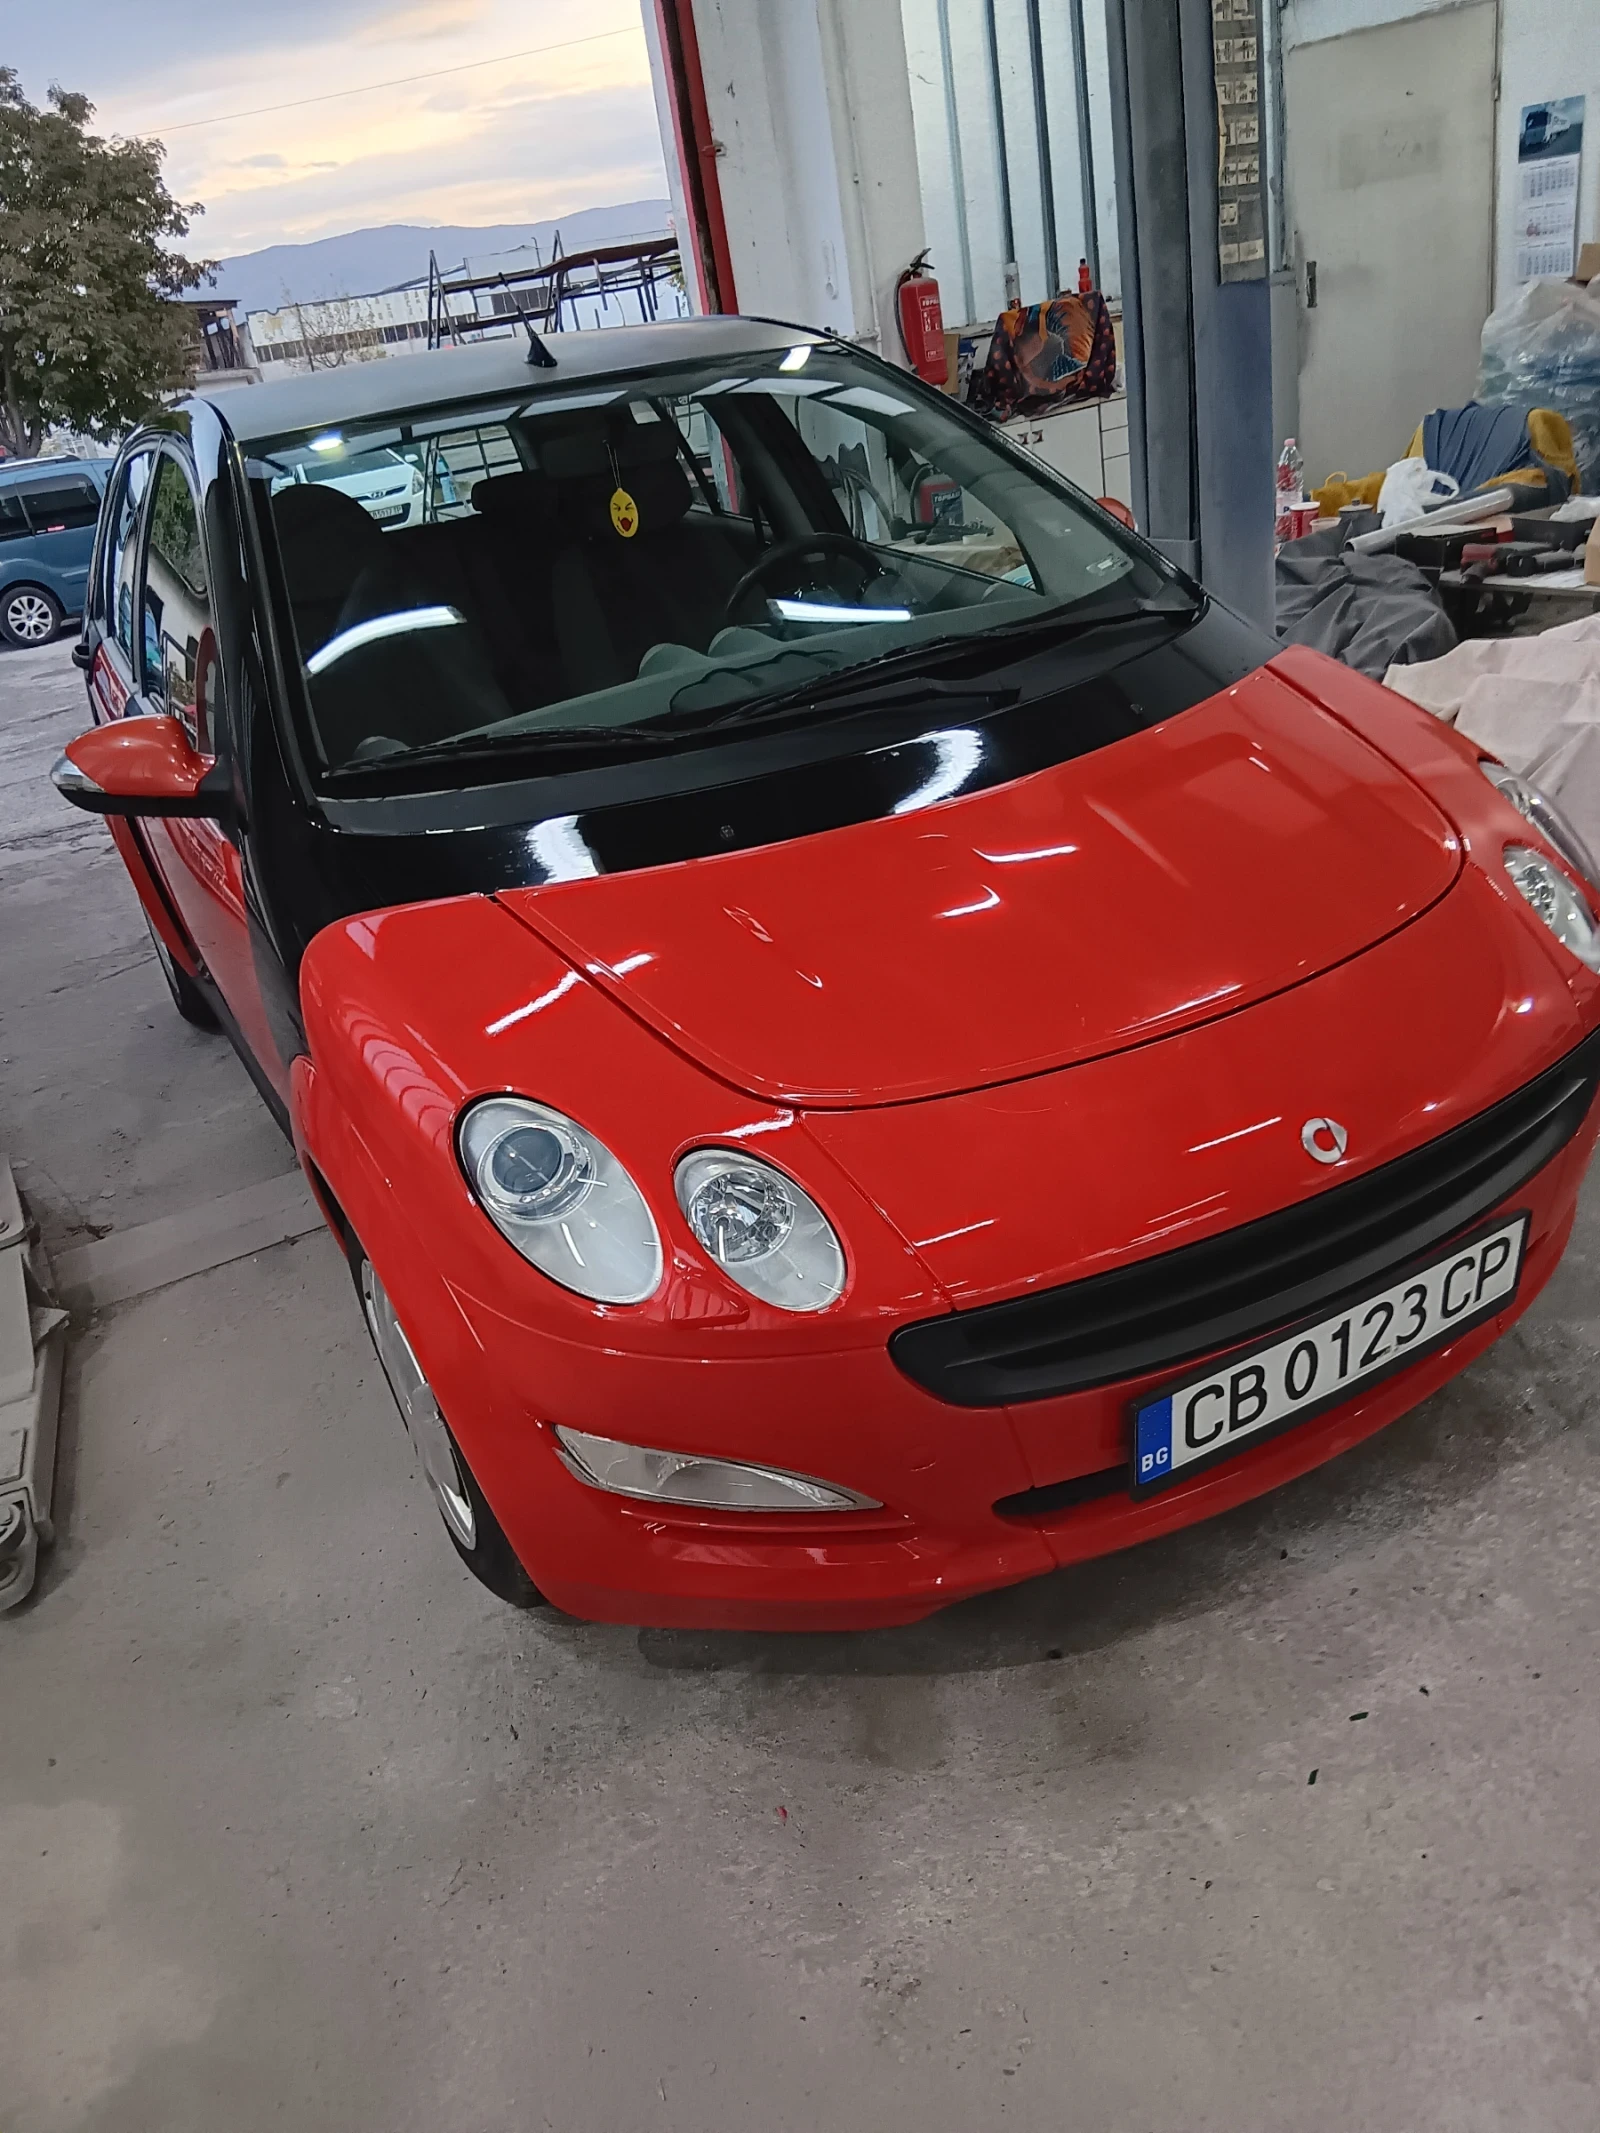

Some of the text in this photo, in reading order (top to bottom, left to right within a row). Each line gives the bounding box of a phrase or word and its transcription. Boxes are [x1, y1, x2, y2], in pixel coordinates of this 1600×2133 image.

[1184, 1236, 1510, 1449] CB 0123 CP
[1141, 1446, 1168, 1473] BG
